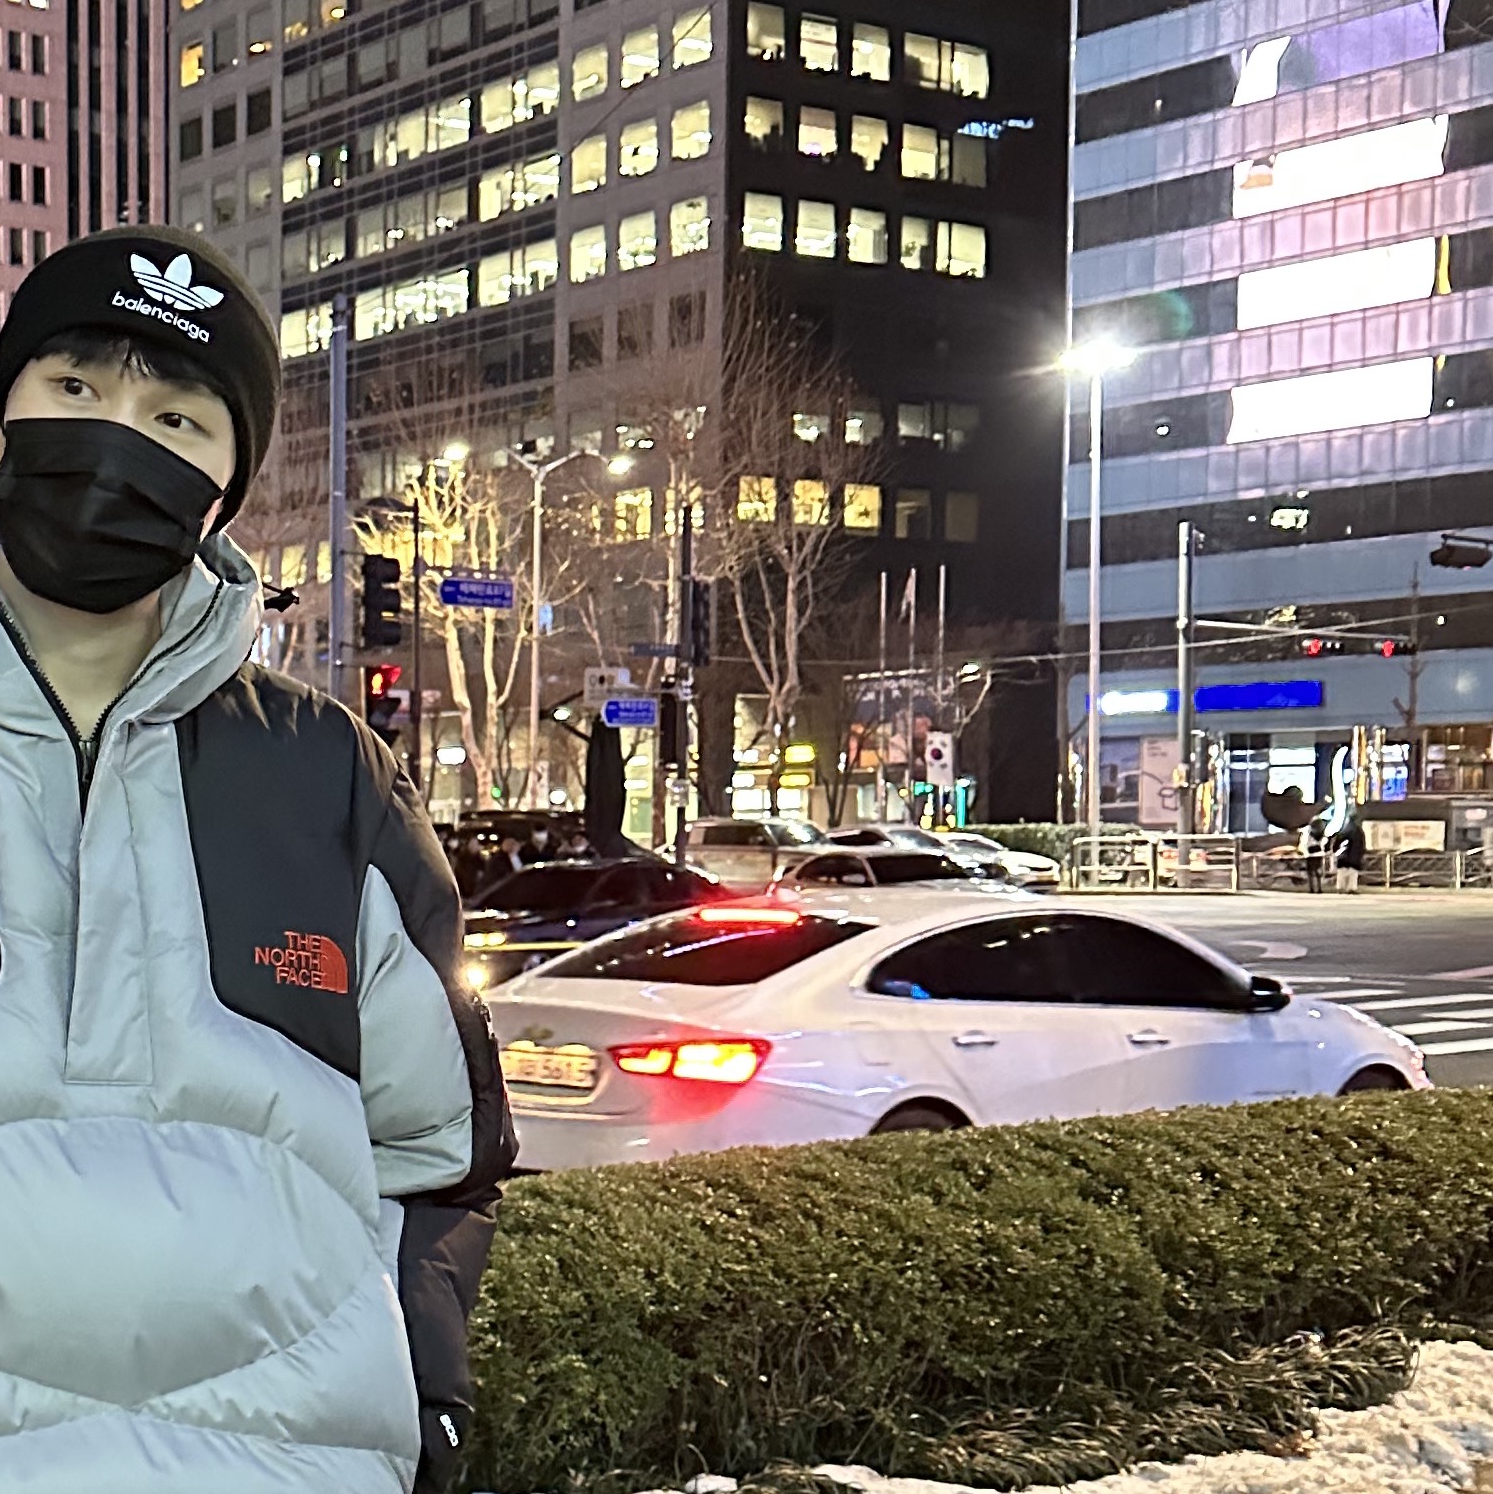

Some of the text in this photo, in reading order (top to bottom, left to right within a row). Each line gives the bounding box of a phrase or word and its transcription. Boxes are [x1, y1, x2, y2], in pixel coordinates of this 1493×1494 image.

[111, 290, 210, 343] balenciaga
[284, 931, 322, 953] THE
[254, 947, 322, 971] NORTH
[275, 967, 325, 989] FACE
